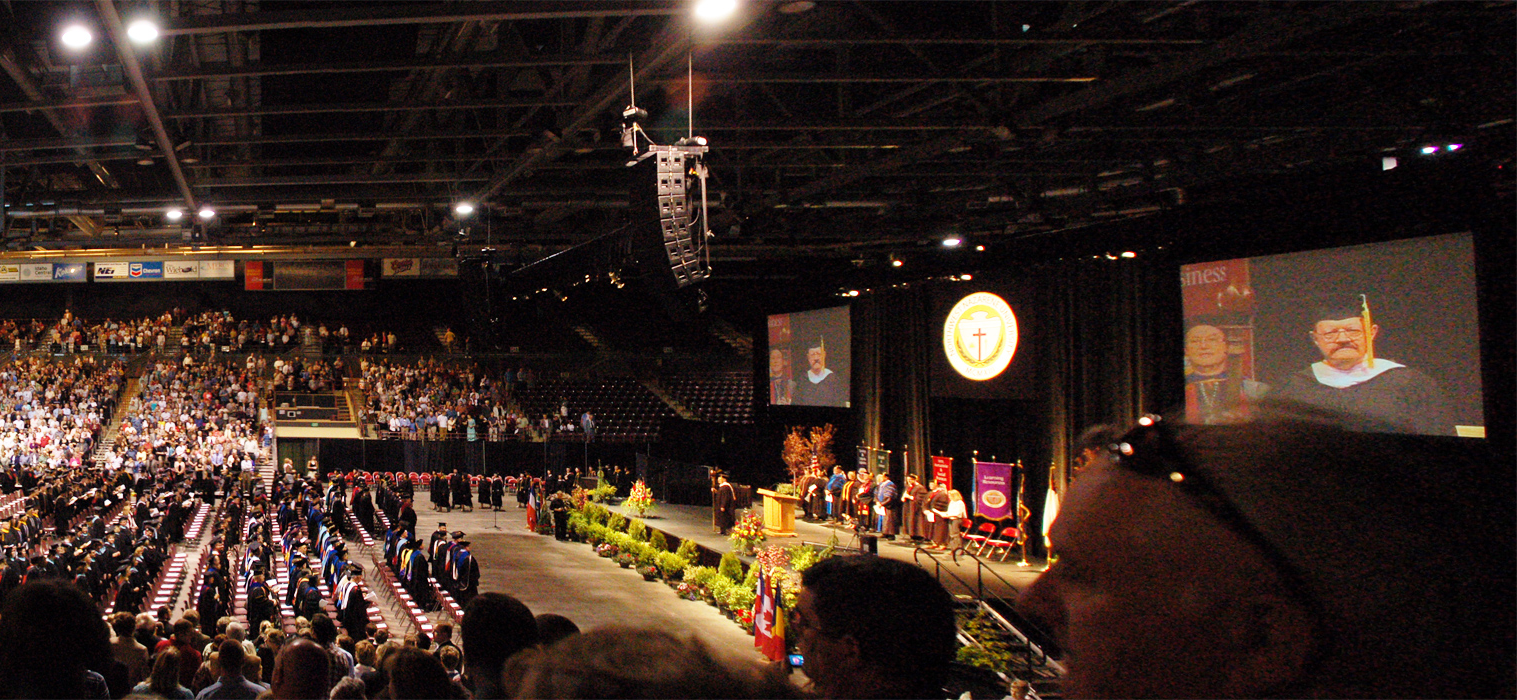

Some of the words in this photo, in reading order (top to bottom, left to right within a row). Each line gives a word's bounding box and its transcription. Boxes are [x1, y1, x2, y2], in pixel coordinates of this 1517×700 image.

[946, 306, 963, 357] NORTHWEST
[962, 295, 1000, 309] NAZARENE
[999, 305, 1015, 356] UNIVERSITY
